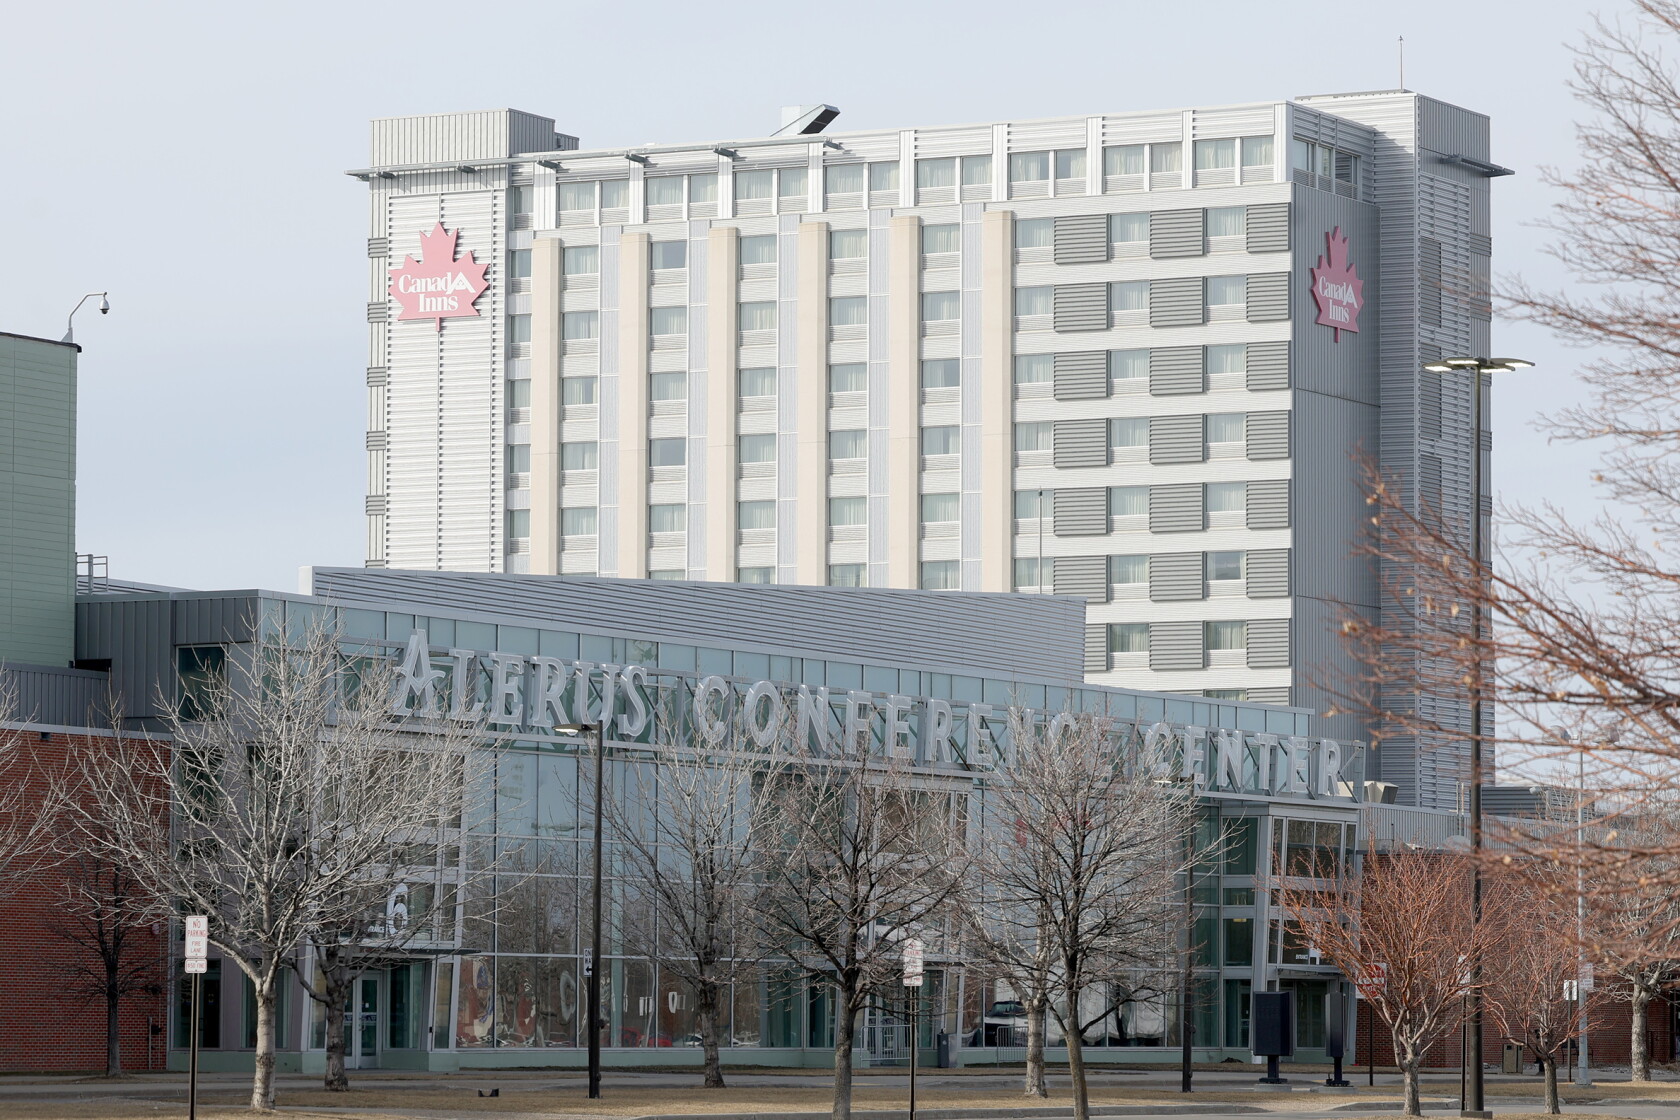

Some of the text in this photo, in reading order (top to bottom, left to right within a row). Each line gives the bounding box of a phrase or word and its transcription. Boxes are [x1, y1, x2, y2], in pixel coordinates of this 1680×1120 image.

[418, 293, 459, 313] Inns
[1329, 299, 1350, 324] Inns
[391, 628, 648, 737] ALERUS
[1142, 721, 1342, 797] CENTER
[192, 921, 201, 929] NO
